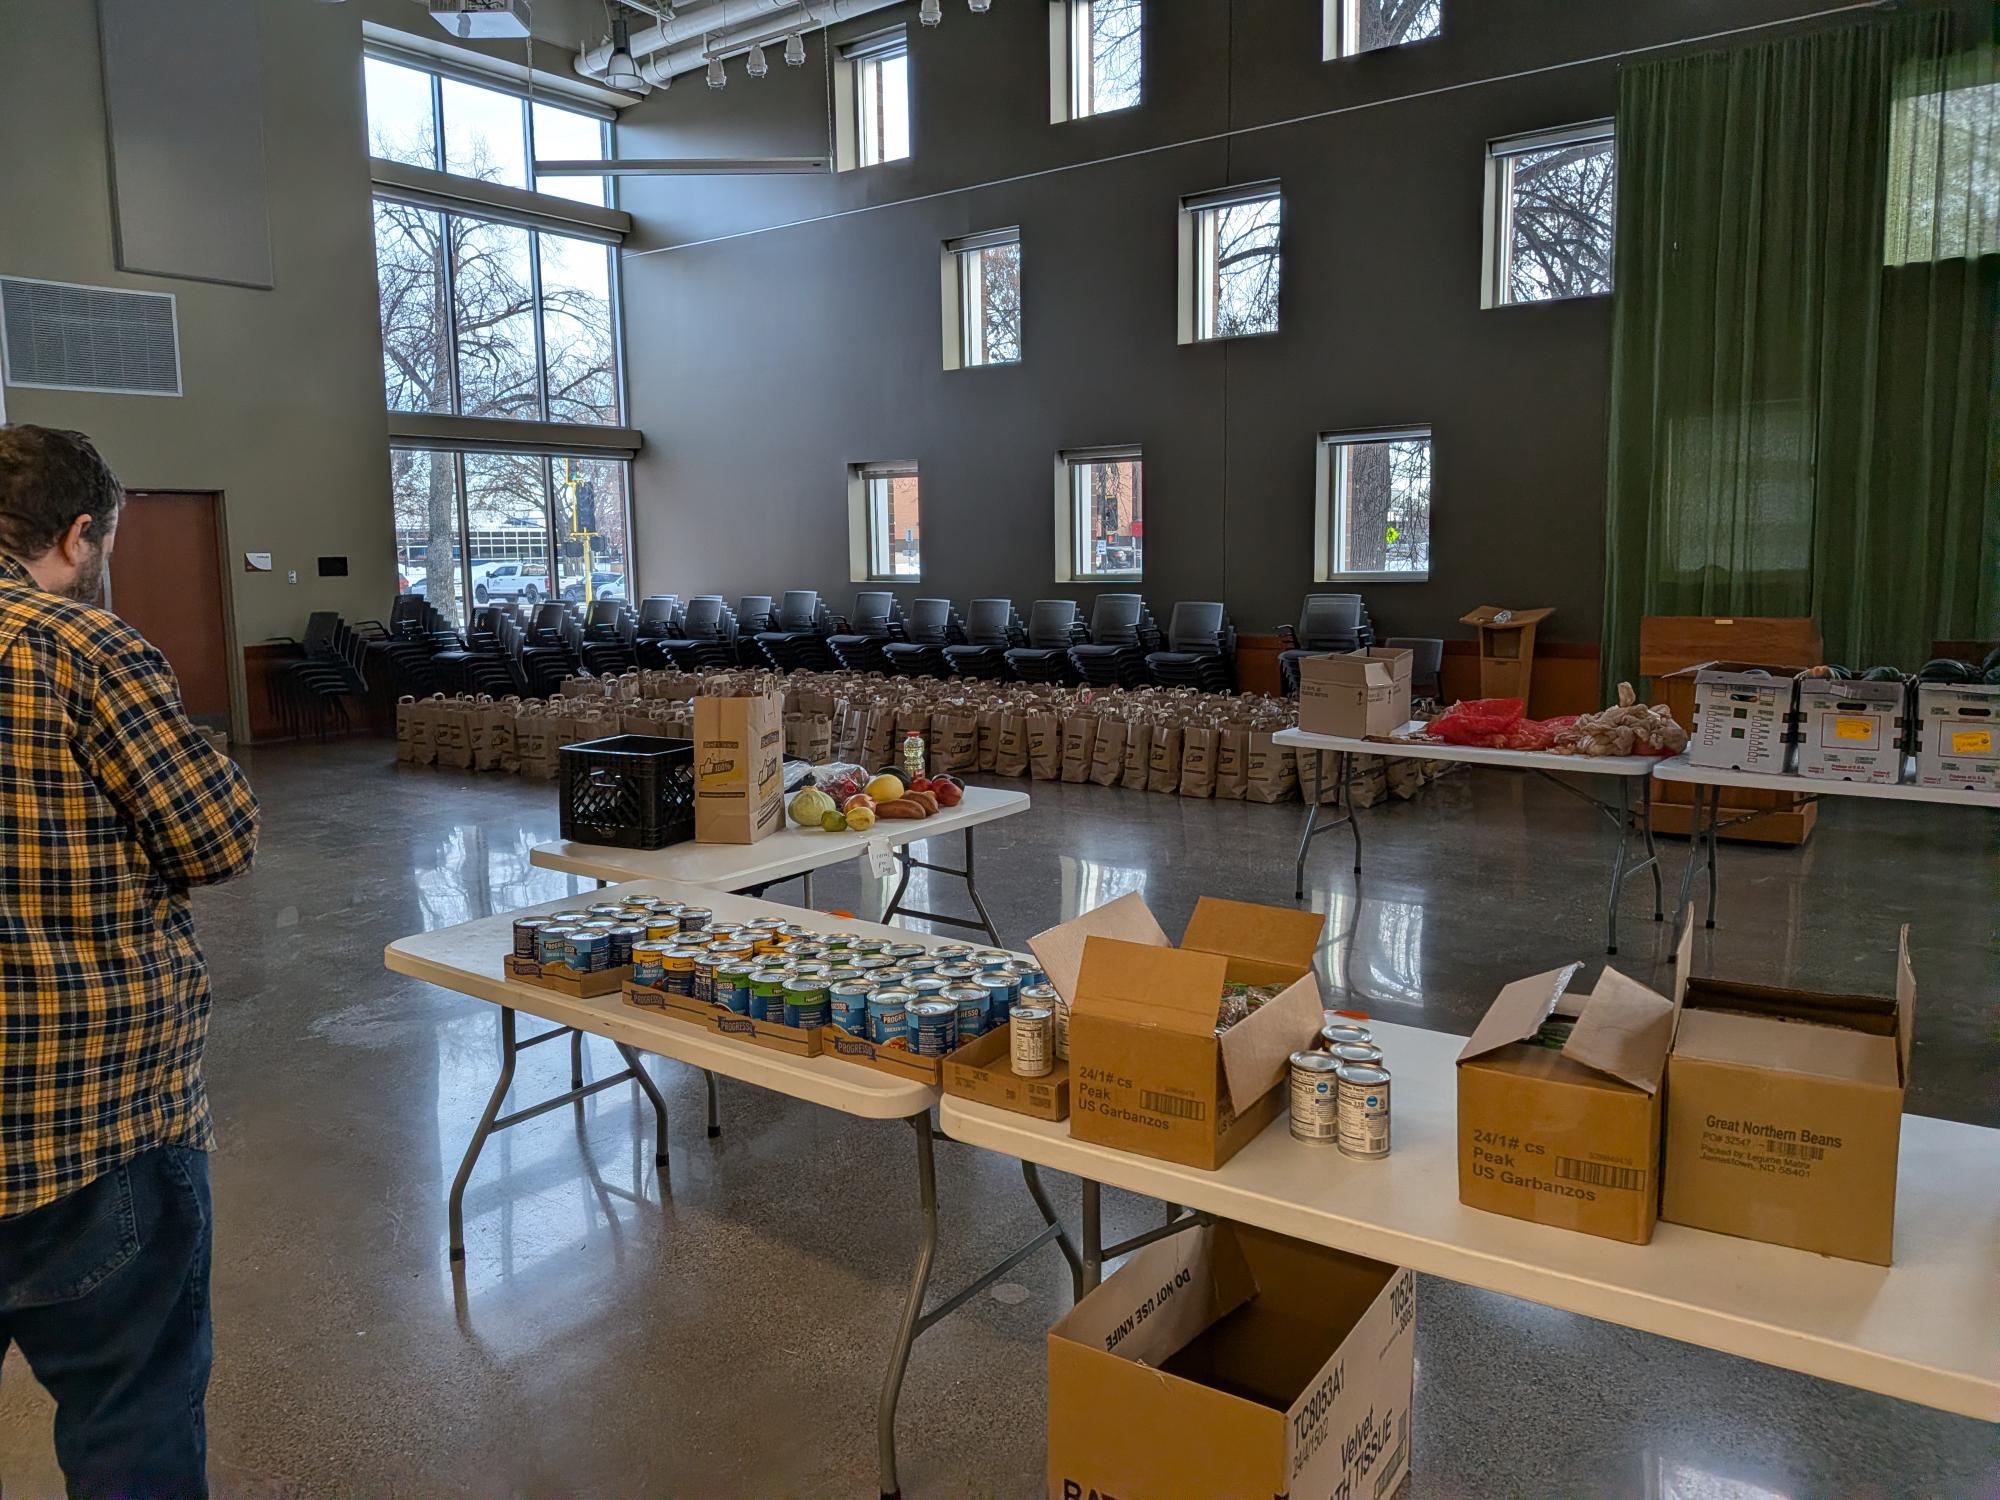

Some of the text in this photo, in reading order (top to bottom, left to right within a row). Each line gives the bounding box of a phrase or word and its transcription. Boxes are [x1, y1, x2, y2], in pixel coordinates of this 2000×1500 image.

[720, 1020, 753, 1033] PROGRESSO
[838, 1041, 873, 1056] PROGRESSO
[1079, 1082, 1111, 1100] Peak
[1080, 1066, 1132, 1089] 24/1# cs
[1078, 1098, 1169, 1130] US Garbanzos
[1474, 1128, 1545, 1155] 24/1# cs
[1706, 1114, 1842, 1149] Great Northern Beans
[1473, 1146, 1515, 1168] Peak
[1472, 1162, 1596, 1201] US Garbanzos
[1105, 1268, 1191, 1352] DO NOT USE KNIFE
[1293, 1358, 1345, 1449] TC8053A1
[1341, 1403, 1374, 1473] Velvet
[1354, 1408, 1393, 1488] TISSUE
